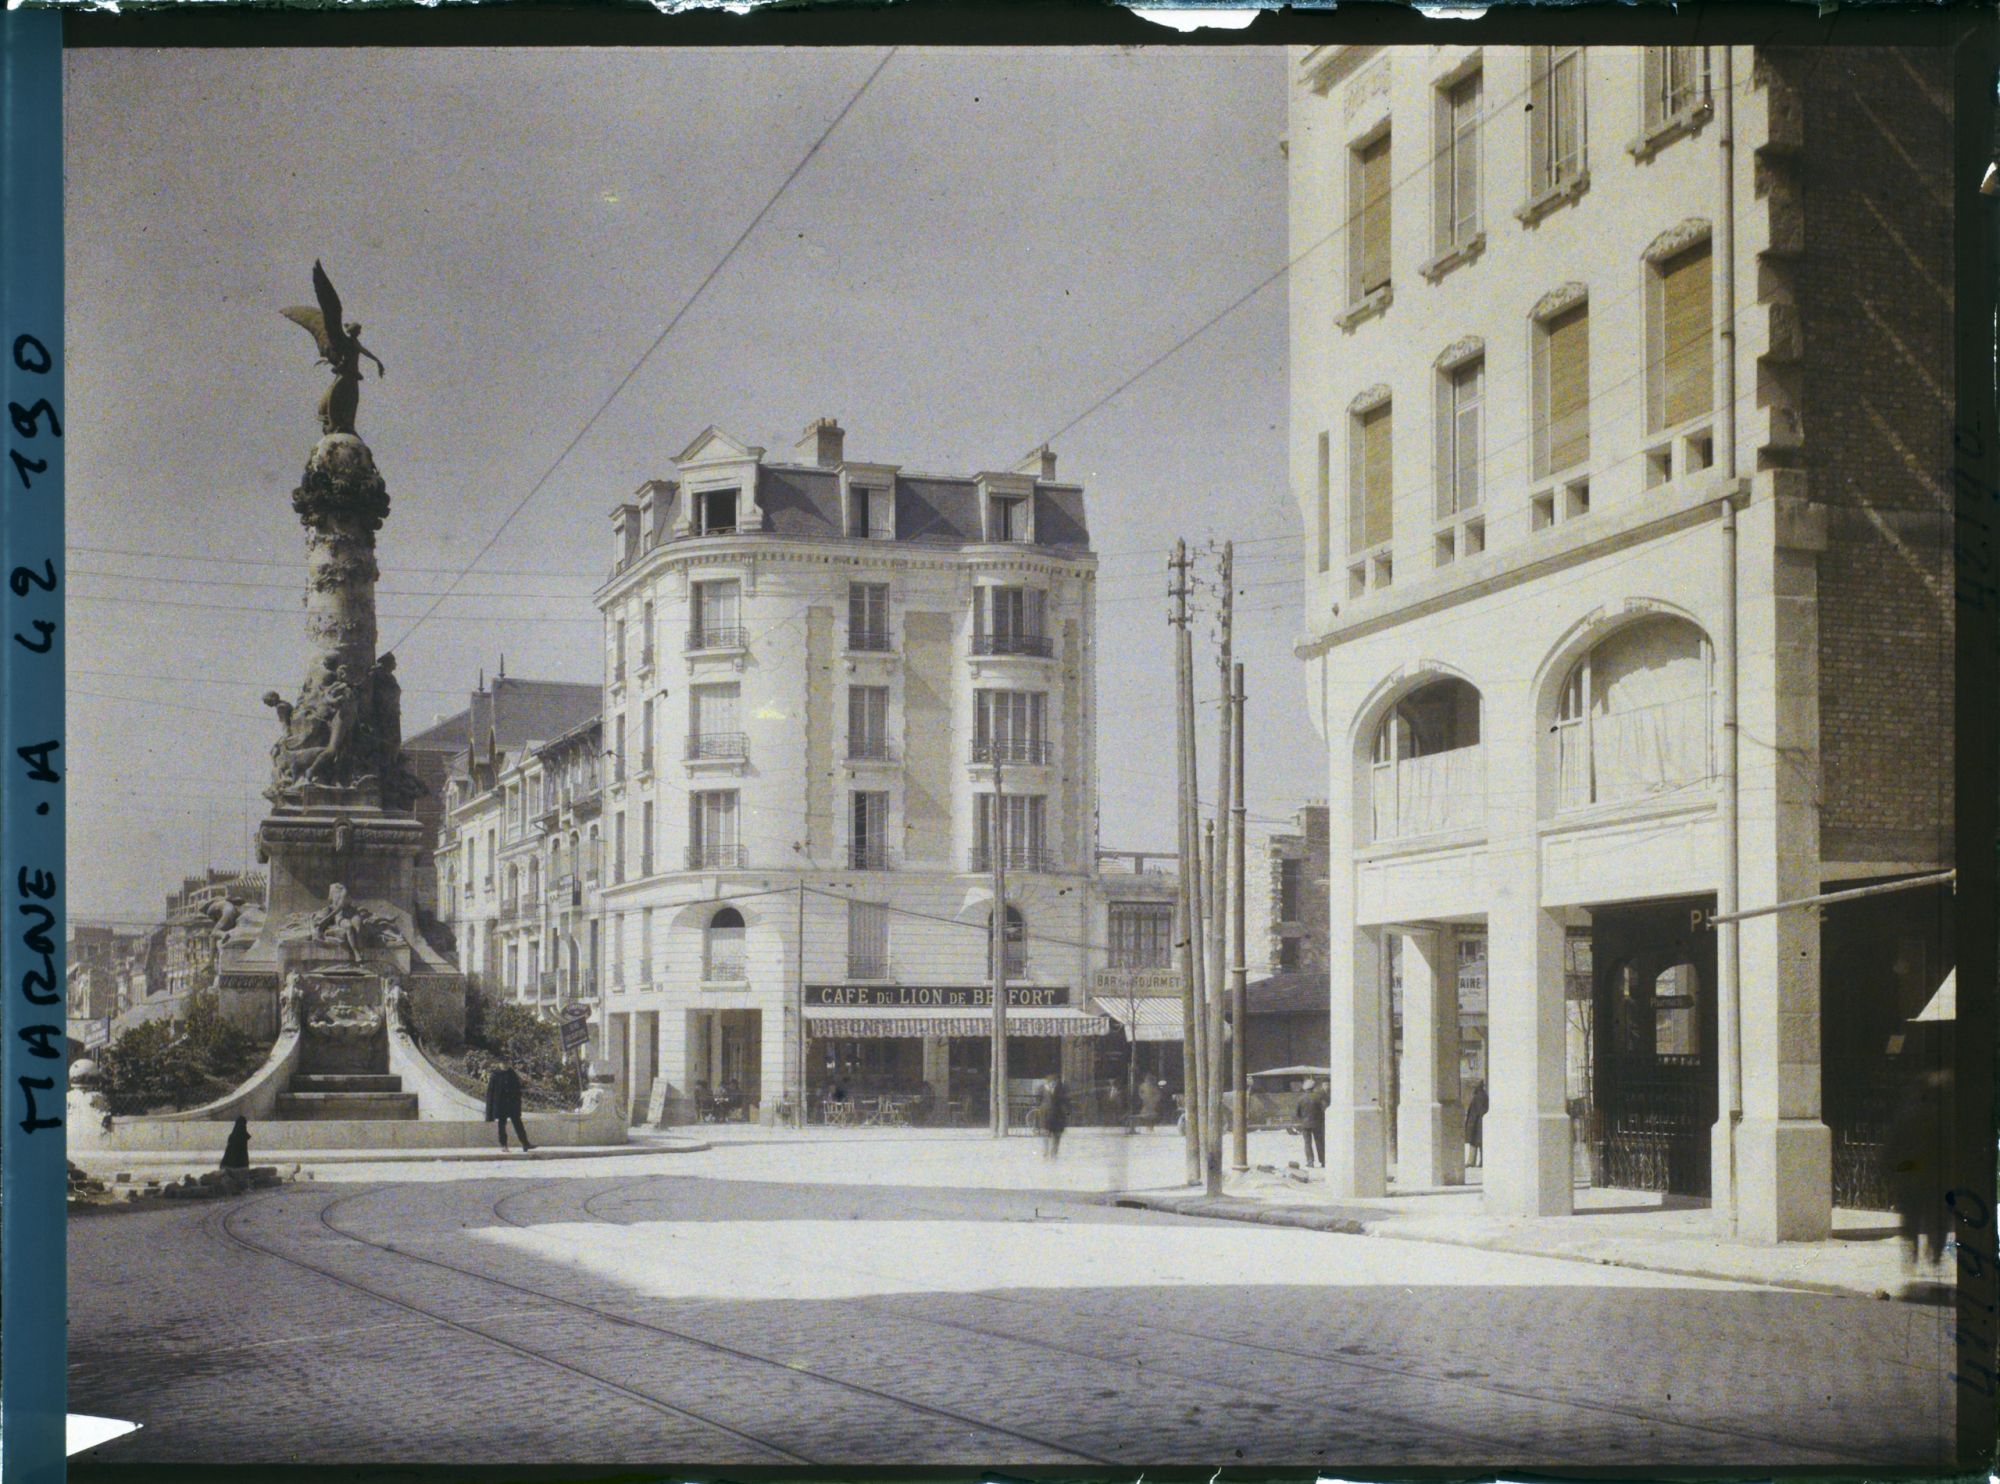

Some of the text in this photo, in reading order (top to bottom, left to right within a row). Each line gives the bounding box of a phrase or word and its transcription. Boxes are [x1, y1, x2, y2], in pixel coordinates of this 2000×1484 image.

[18, 865, 62, 1136] MARNE
[821, 987, 869, 1005] CAFE
[900, 988, 943, 1006] LION
[950, 992, 966, 1006] DE
[973, 989, 1055, 1006] BEFORT
